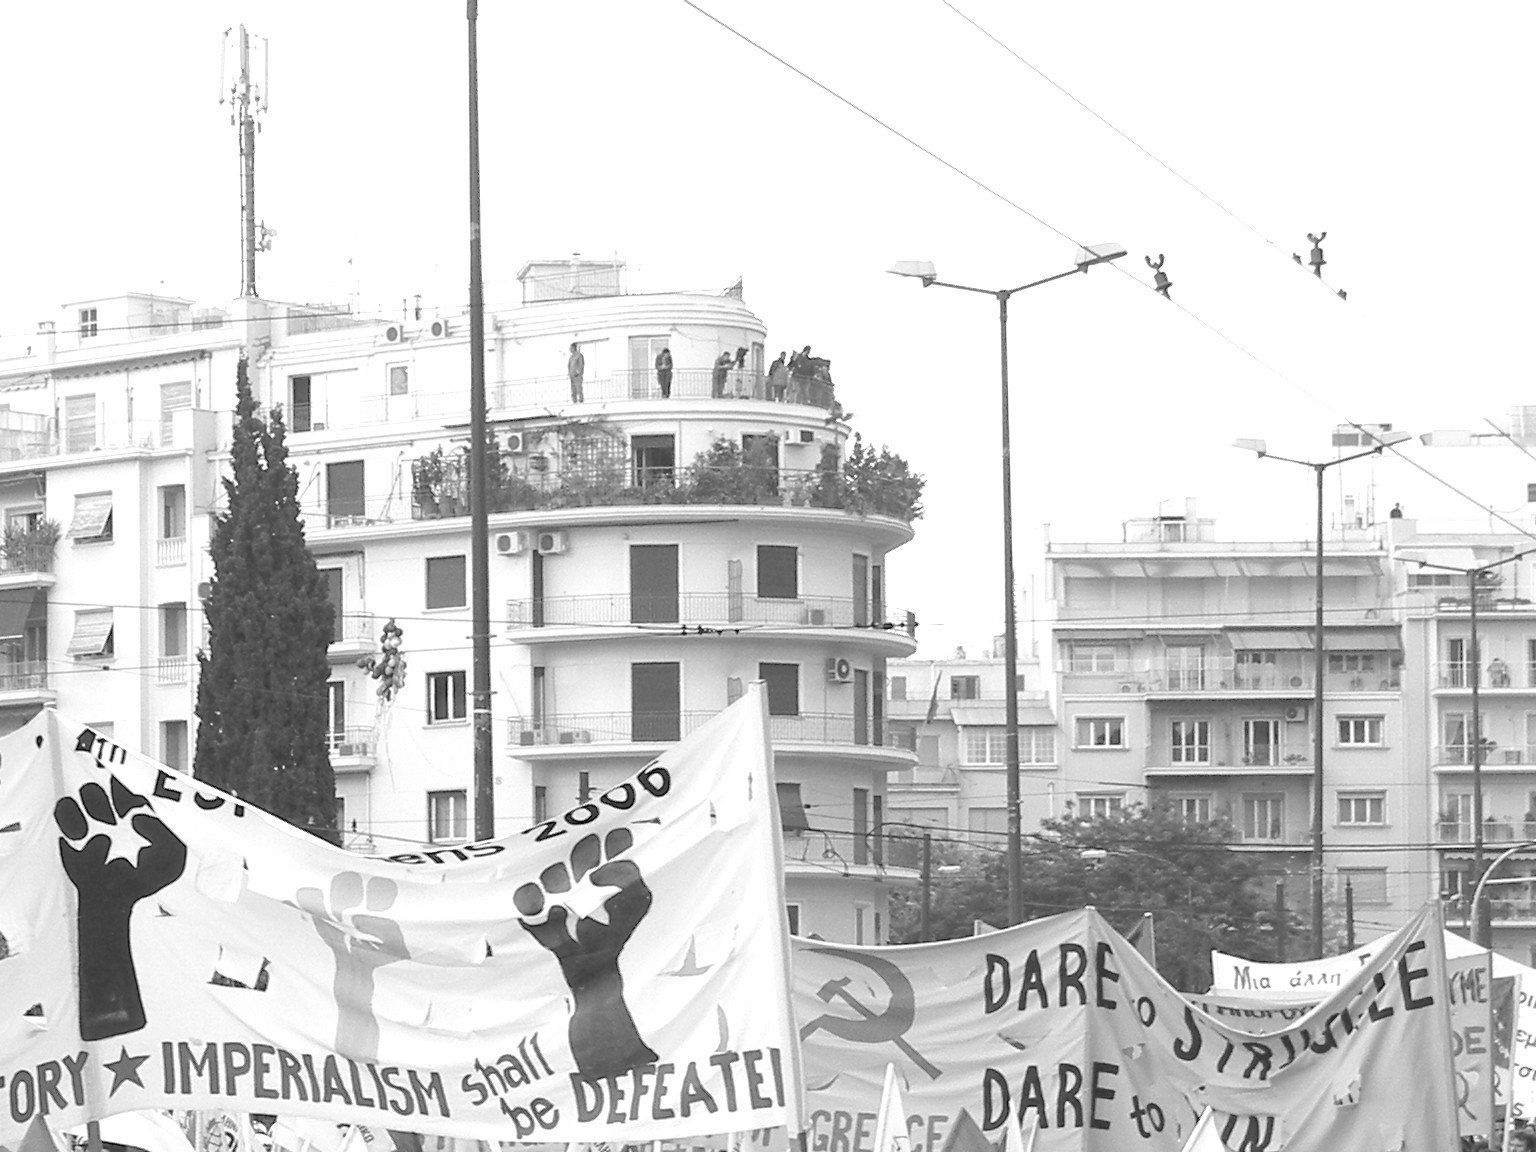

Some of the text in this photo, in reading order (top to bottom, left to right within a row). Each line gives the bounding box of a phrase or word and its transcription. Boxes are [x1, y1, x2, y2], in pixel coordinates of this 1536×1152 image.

[984, 942, 1121, 1015] DARE
[1233, 965, 1272, 990] Μια
[161, 1041, 451, 1117] IMPERIALISM
[460, 1033, 556, 1107] shall
[982, 1062, 1120, 1132] DARE
[1130, 1095, 1164, 1139] to
[500, 1092, 560, 1140] be
